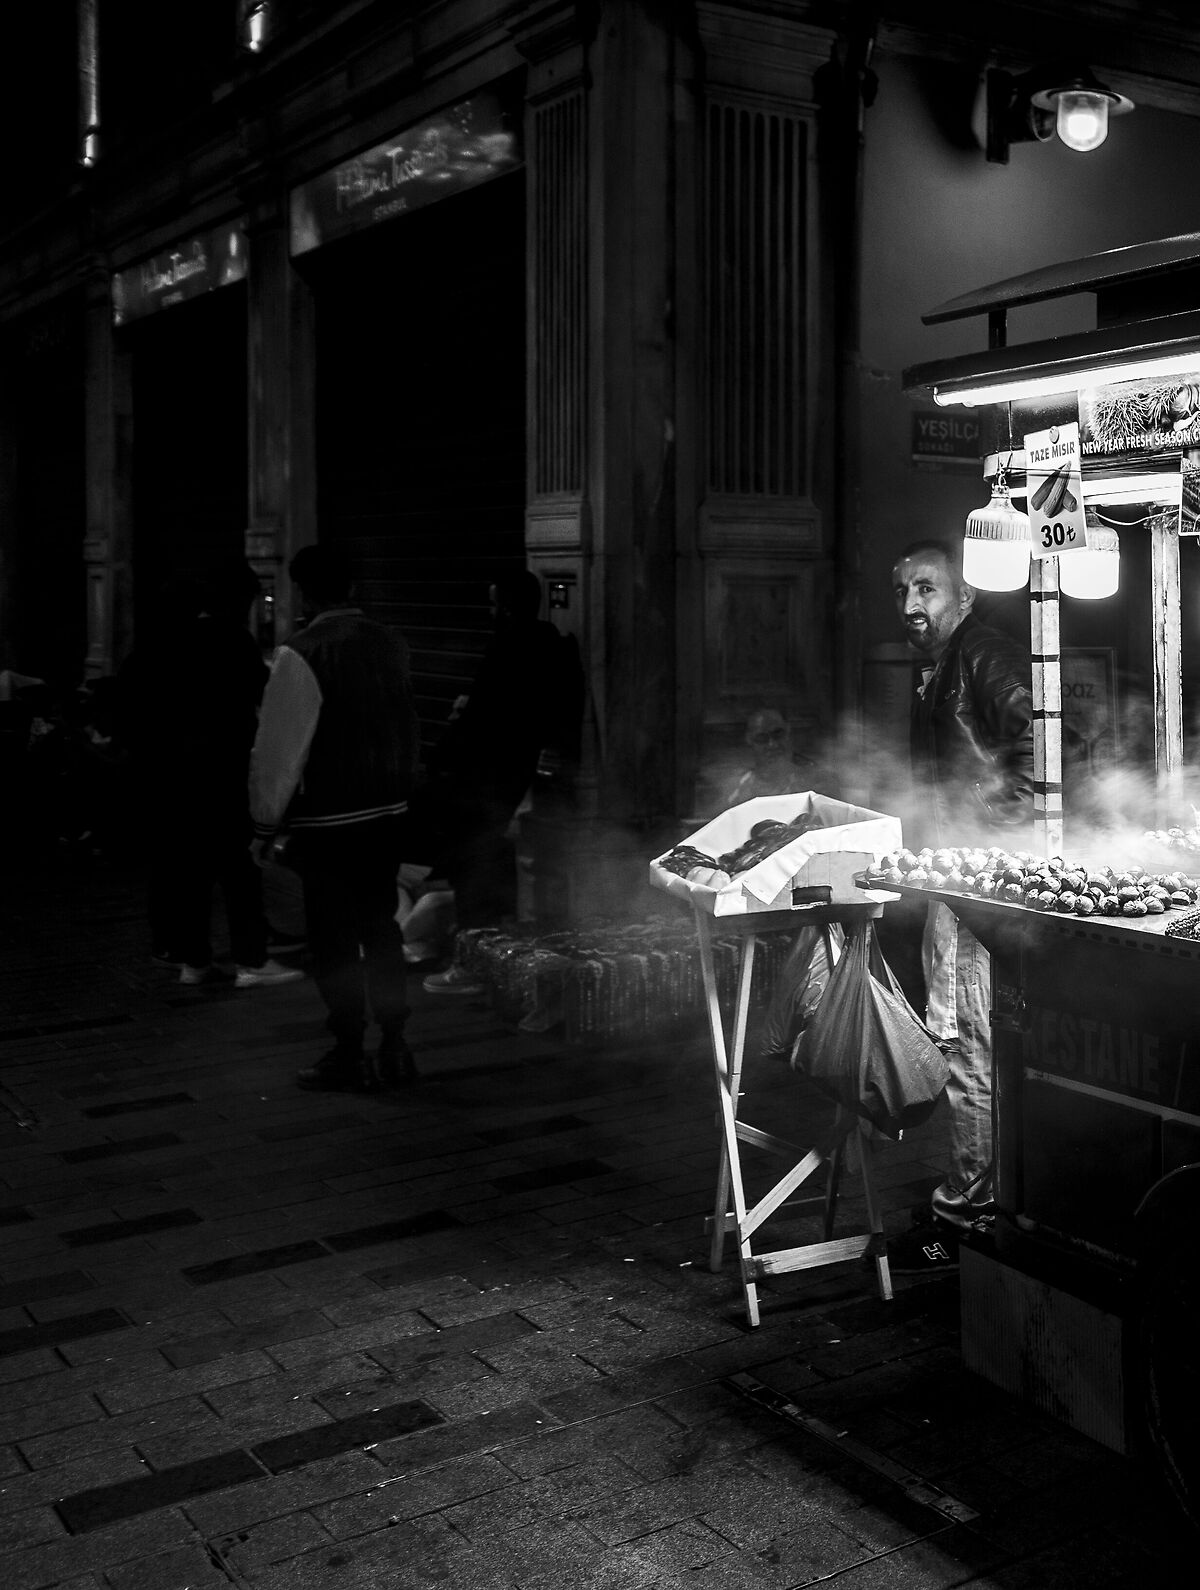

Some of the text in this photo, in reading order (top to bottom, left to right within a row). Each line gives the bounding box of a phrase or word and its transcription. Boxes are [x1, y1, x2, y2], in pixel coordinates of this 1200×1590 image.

[1030, 441, 1075, 463] TAZE MISIR
[1082, 441, 1102, 454] NEW
[1104, 438, 1125, 452] YEAR
[1126, 434, 1151, 449] FRESH
[1155, 428, 1192, 446] SEASON
